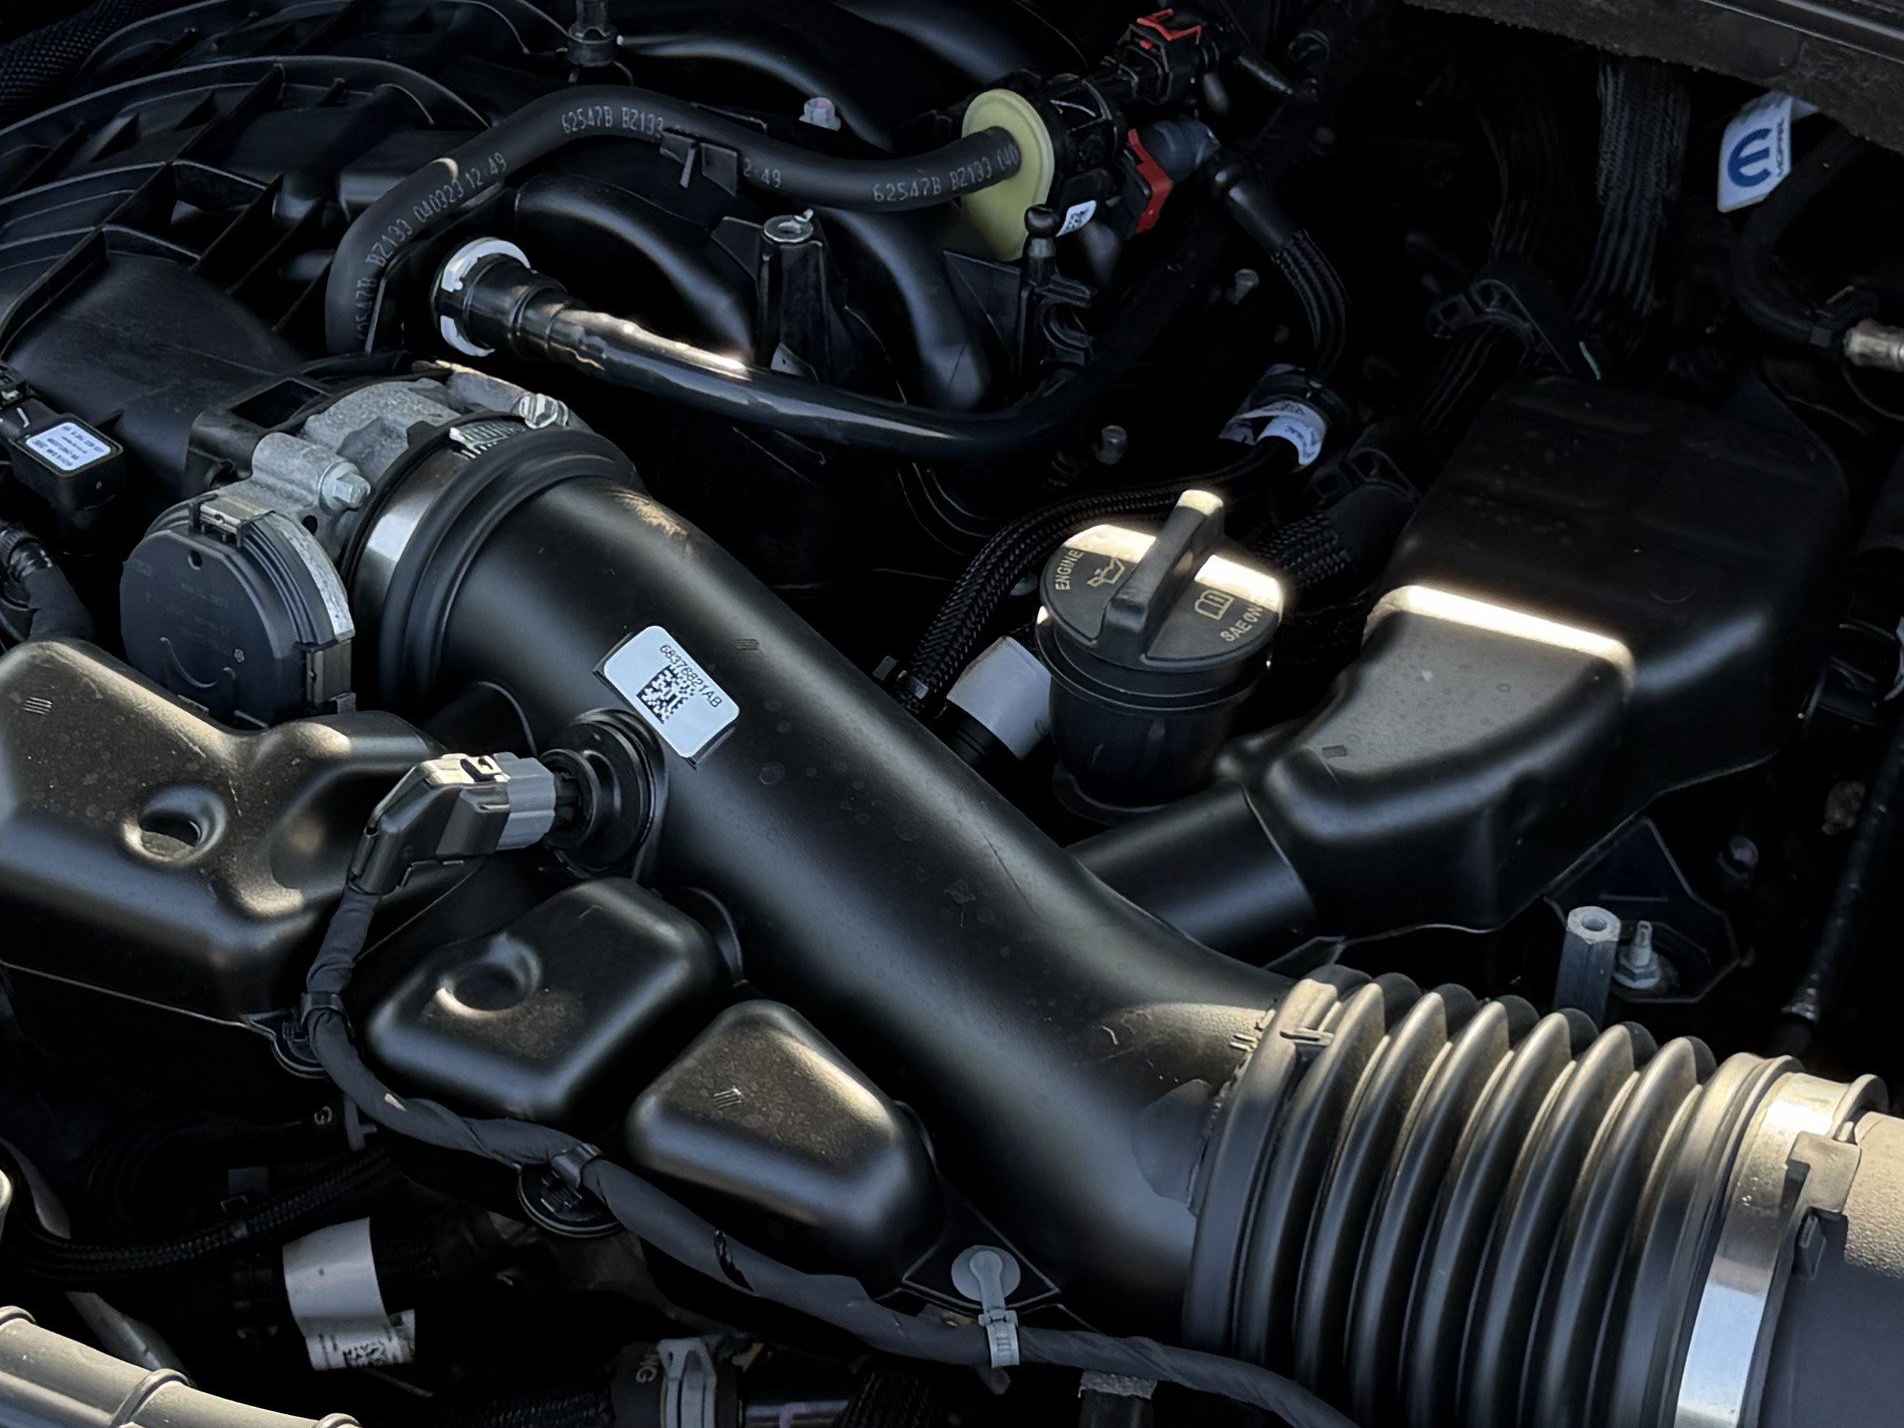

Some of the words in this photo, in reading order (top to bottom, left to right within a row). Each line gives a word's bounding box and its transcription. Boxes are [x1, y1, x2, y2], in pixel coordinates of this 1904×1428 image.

[561, 106, 613, 134] 62547B
[873, 176, 942, 203] 62547B
[950, 156, 993, 191] BZ133
[1054, 549, 1084, 591] ENGINE
[1219, 620, 1253, 642] SAE
[659, 644, 723, 708] 68376821AB
